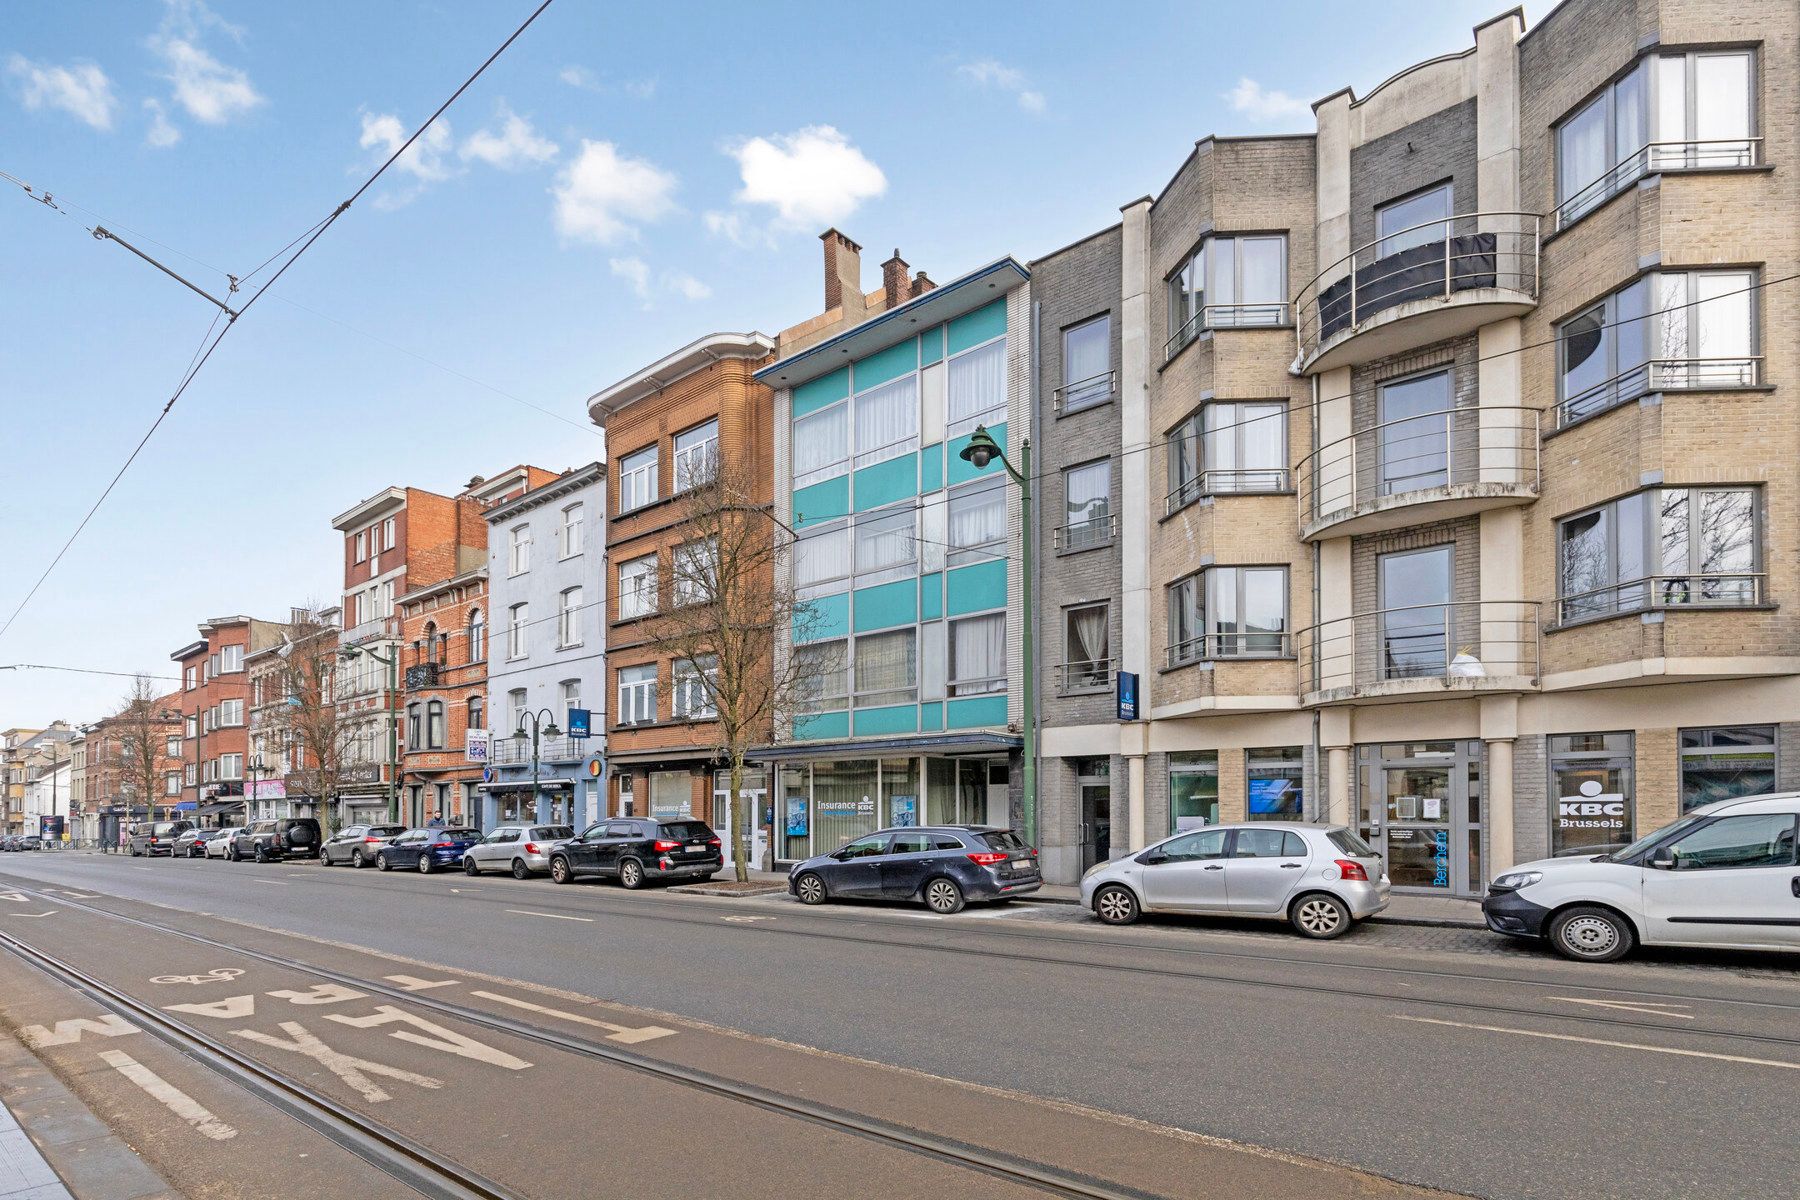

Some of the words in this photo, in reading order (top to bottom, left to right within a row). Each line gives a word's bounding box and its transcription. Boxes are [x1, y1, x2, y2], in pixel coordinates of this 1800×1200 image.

[1121, 703, 1134, 711] KBC
[817, 800, 856, 810] Insurance
[1560, 803, 1624, 816] KBC
[1560, 818, 1624, 828] Brussels
[1433, 831, 1448, 887] Berchem
[20, 975, 462, 1049] TRAM
[98, 990, 681, 1141] TAXI
